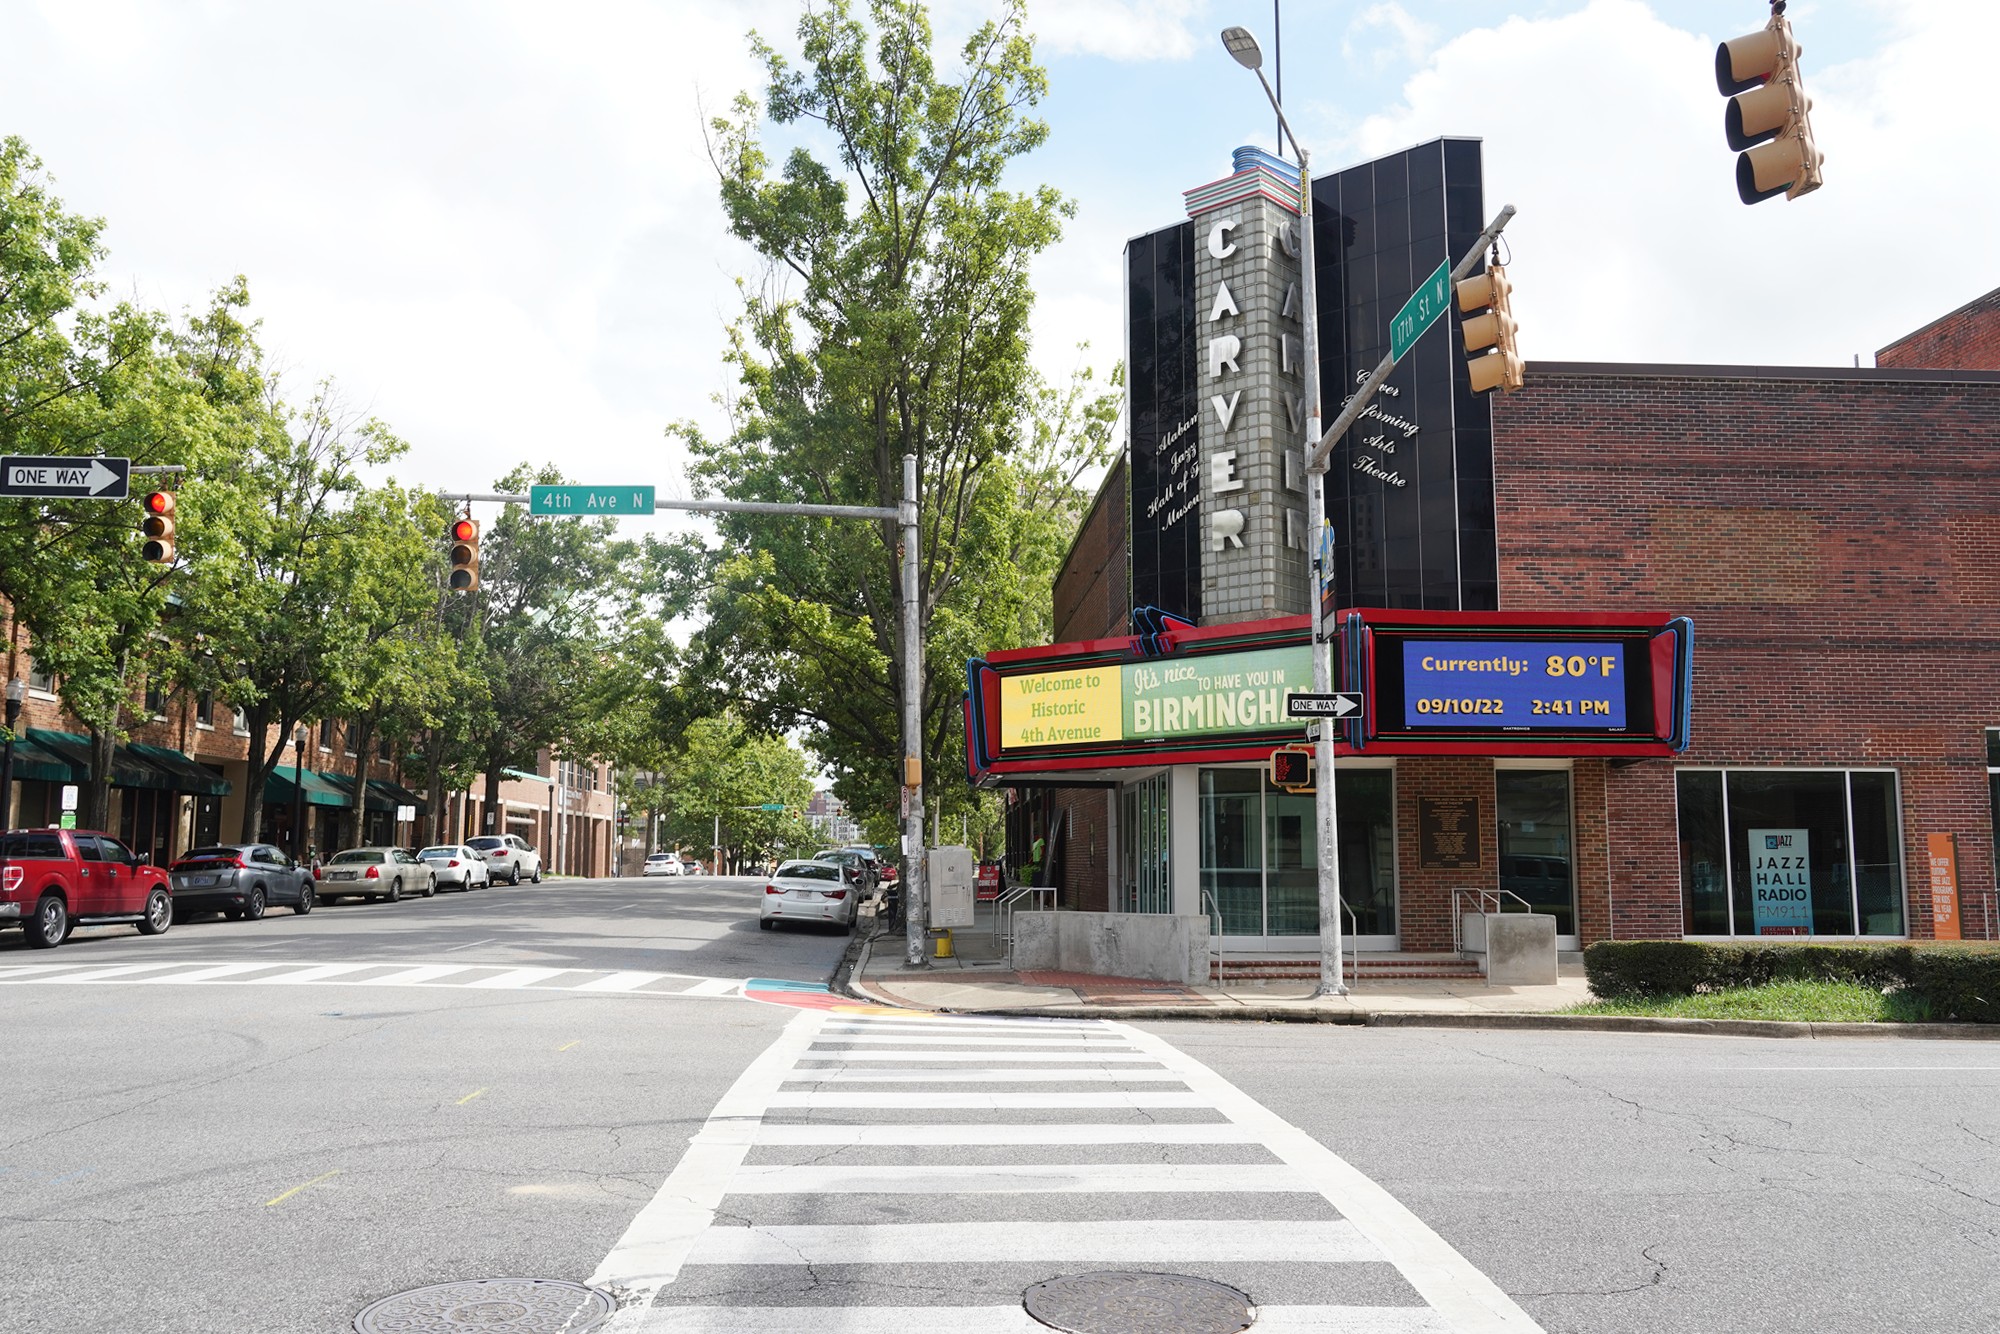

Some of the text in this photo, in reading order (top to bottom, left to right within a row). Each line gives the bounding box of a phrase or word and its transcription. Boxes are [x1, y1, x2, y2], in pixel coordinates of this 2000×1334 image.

[1397, 278, 1443, 347] 17th St N
[1207, 220, 1245, 552] CARVER
[1356, 369, 1400, 397] Cver
[1363, 435, 1396, 454] Arts
[1170, 442, 1197, 475] Jazz
[15, 469, 90, 484] ONE WAY
[1352, 455, 1407, 487] Theatre
[543, 492, 643, 508] 4th Ave N
[1147, 470, 1189, 519] Hall of
[1161, 494, 1200, 532] Museu
[1421, 655, 1616, 677] Currently: 80°F
[1020, 674, 1101, 694] Welcome to
[1134, 663, 1285, 696] It's nice TO HAVE YOU IN
[1031, 699, 1086, 718] Historic
[1293, 701, 1338, 710] ONE WAY
[1416, 698, 1610, 715] 09/10/22 2:41 PM
[1020, 726, 1102, 743] 4th Avenue
[1776, 835, 1793, 847] JAZZ
[1756, 857, 1805, 869] JAZZ
[1757, 873, 1806, 885] HALL
[1758, 889, 1807, 901] RADIO
[1758, 906, 1809, 918] FM91.1
